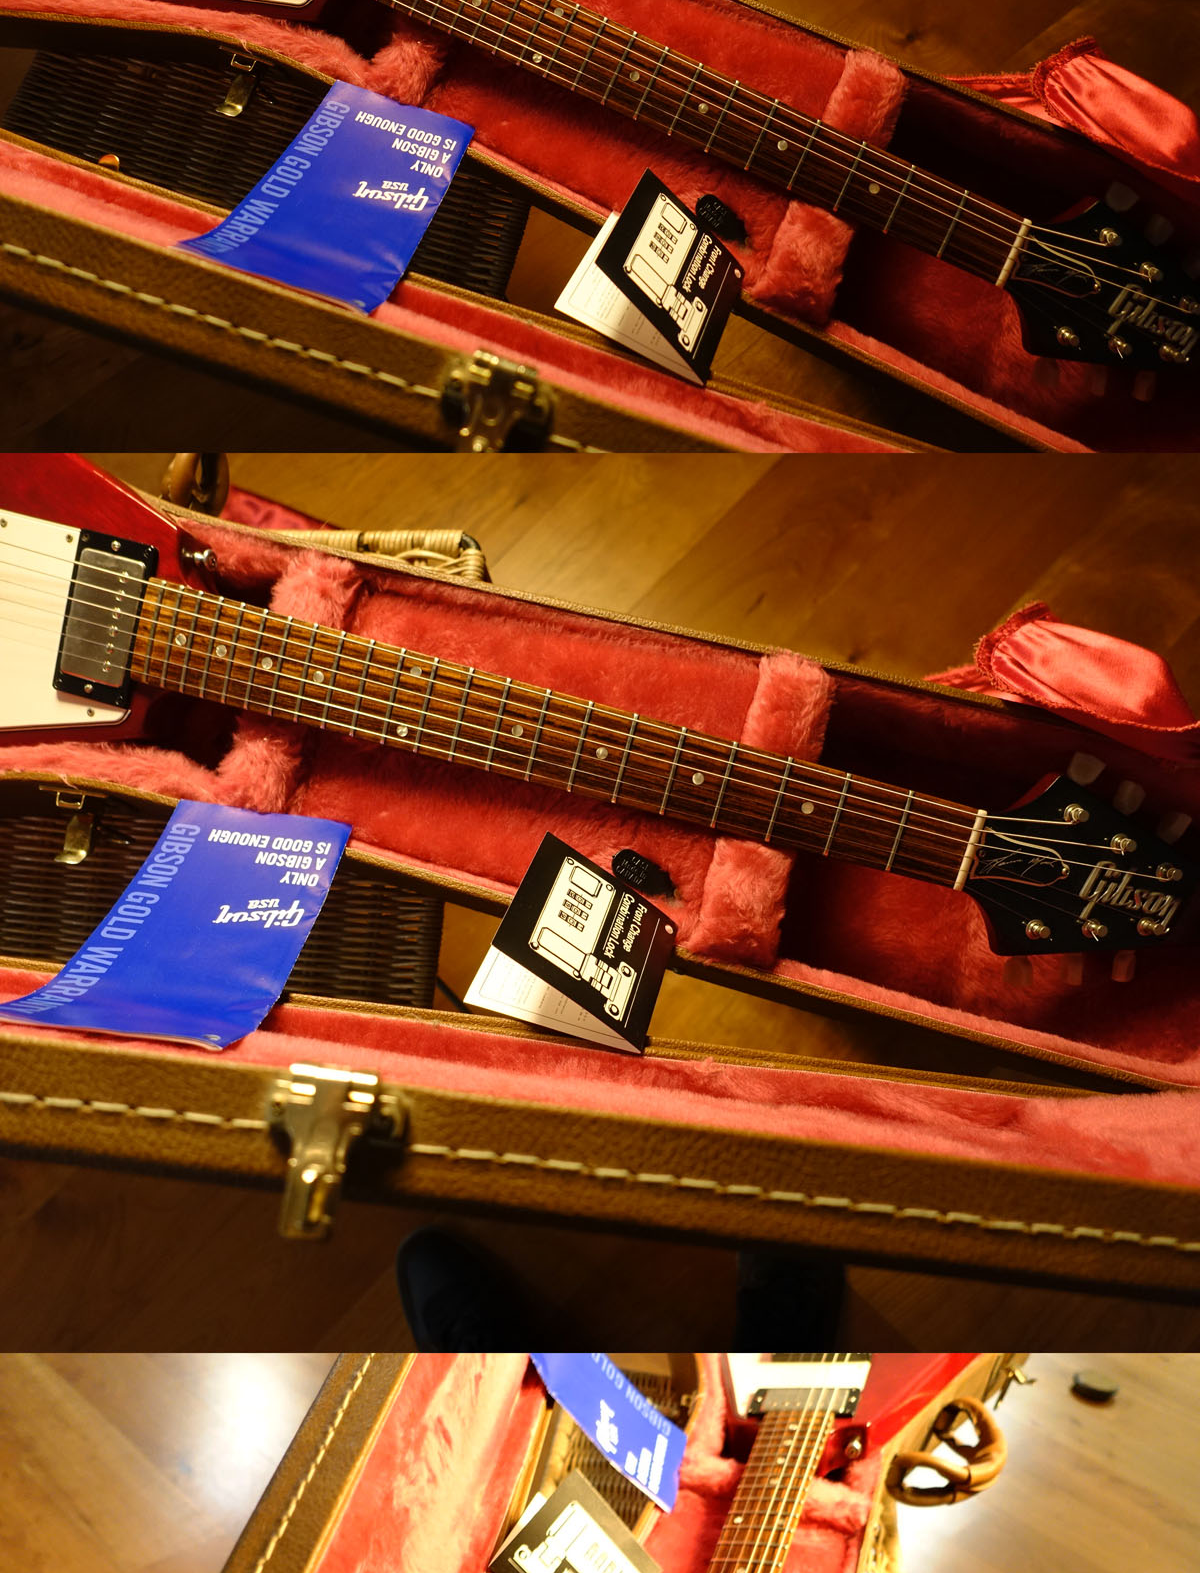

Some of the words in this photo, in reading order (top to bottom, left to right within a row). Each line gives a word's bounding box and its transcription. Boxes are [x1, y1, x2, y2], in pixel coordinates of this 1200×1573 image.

[294, 99, 351, 160] GIBSON
[354, 110, 407, 136] ENOUGH
[406, 127, 442, 146] GOOD
[442, 138, 457, 151] IS
[391, 138, 440, 161] GIBSON
[441, 152, 452, 164] A
[261, 154, 312, 199] GOLD
[410, 159, 444, 178] ONLY
[352, 180, 429, 212] Gibson
[1107, 283, 1199, 355] Gibson
[207, 828, 270, 848] ENOUGH
[271, 837, 313, 853] GOOD
[315, 842, 331, 855] IS
[138, 823, 201, 888] GIBSON
[255, 851, 313, 870] GIBSON
[315, 857, 327, 870] A
[279, 871, 319, 887] ONLY
[1079, 860, 1181, 929] Gibson
[100, 890, 161, 941] GOLD
[212, 900, 305, 929] Gibson
[610, 893, 635, 940] Combination
[632, 903, 648, 926] Front
[604, 938, 620, 959] Lock
[623, 924, 641, 952] Change
[625, 1383, 672, 1437] GIBSON
